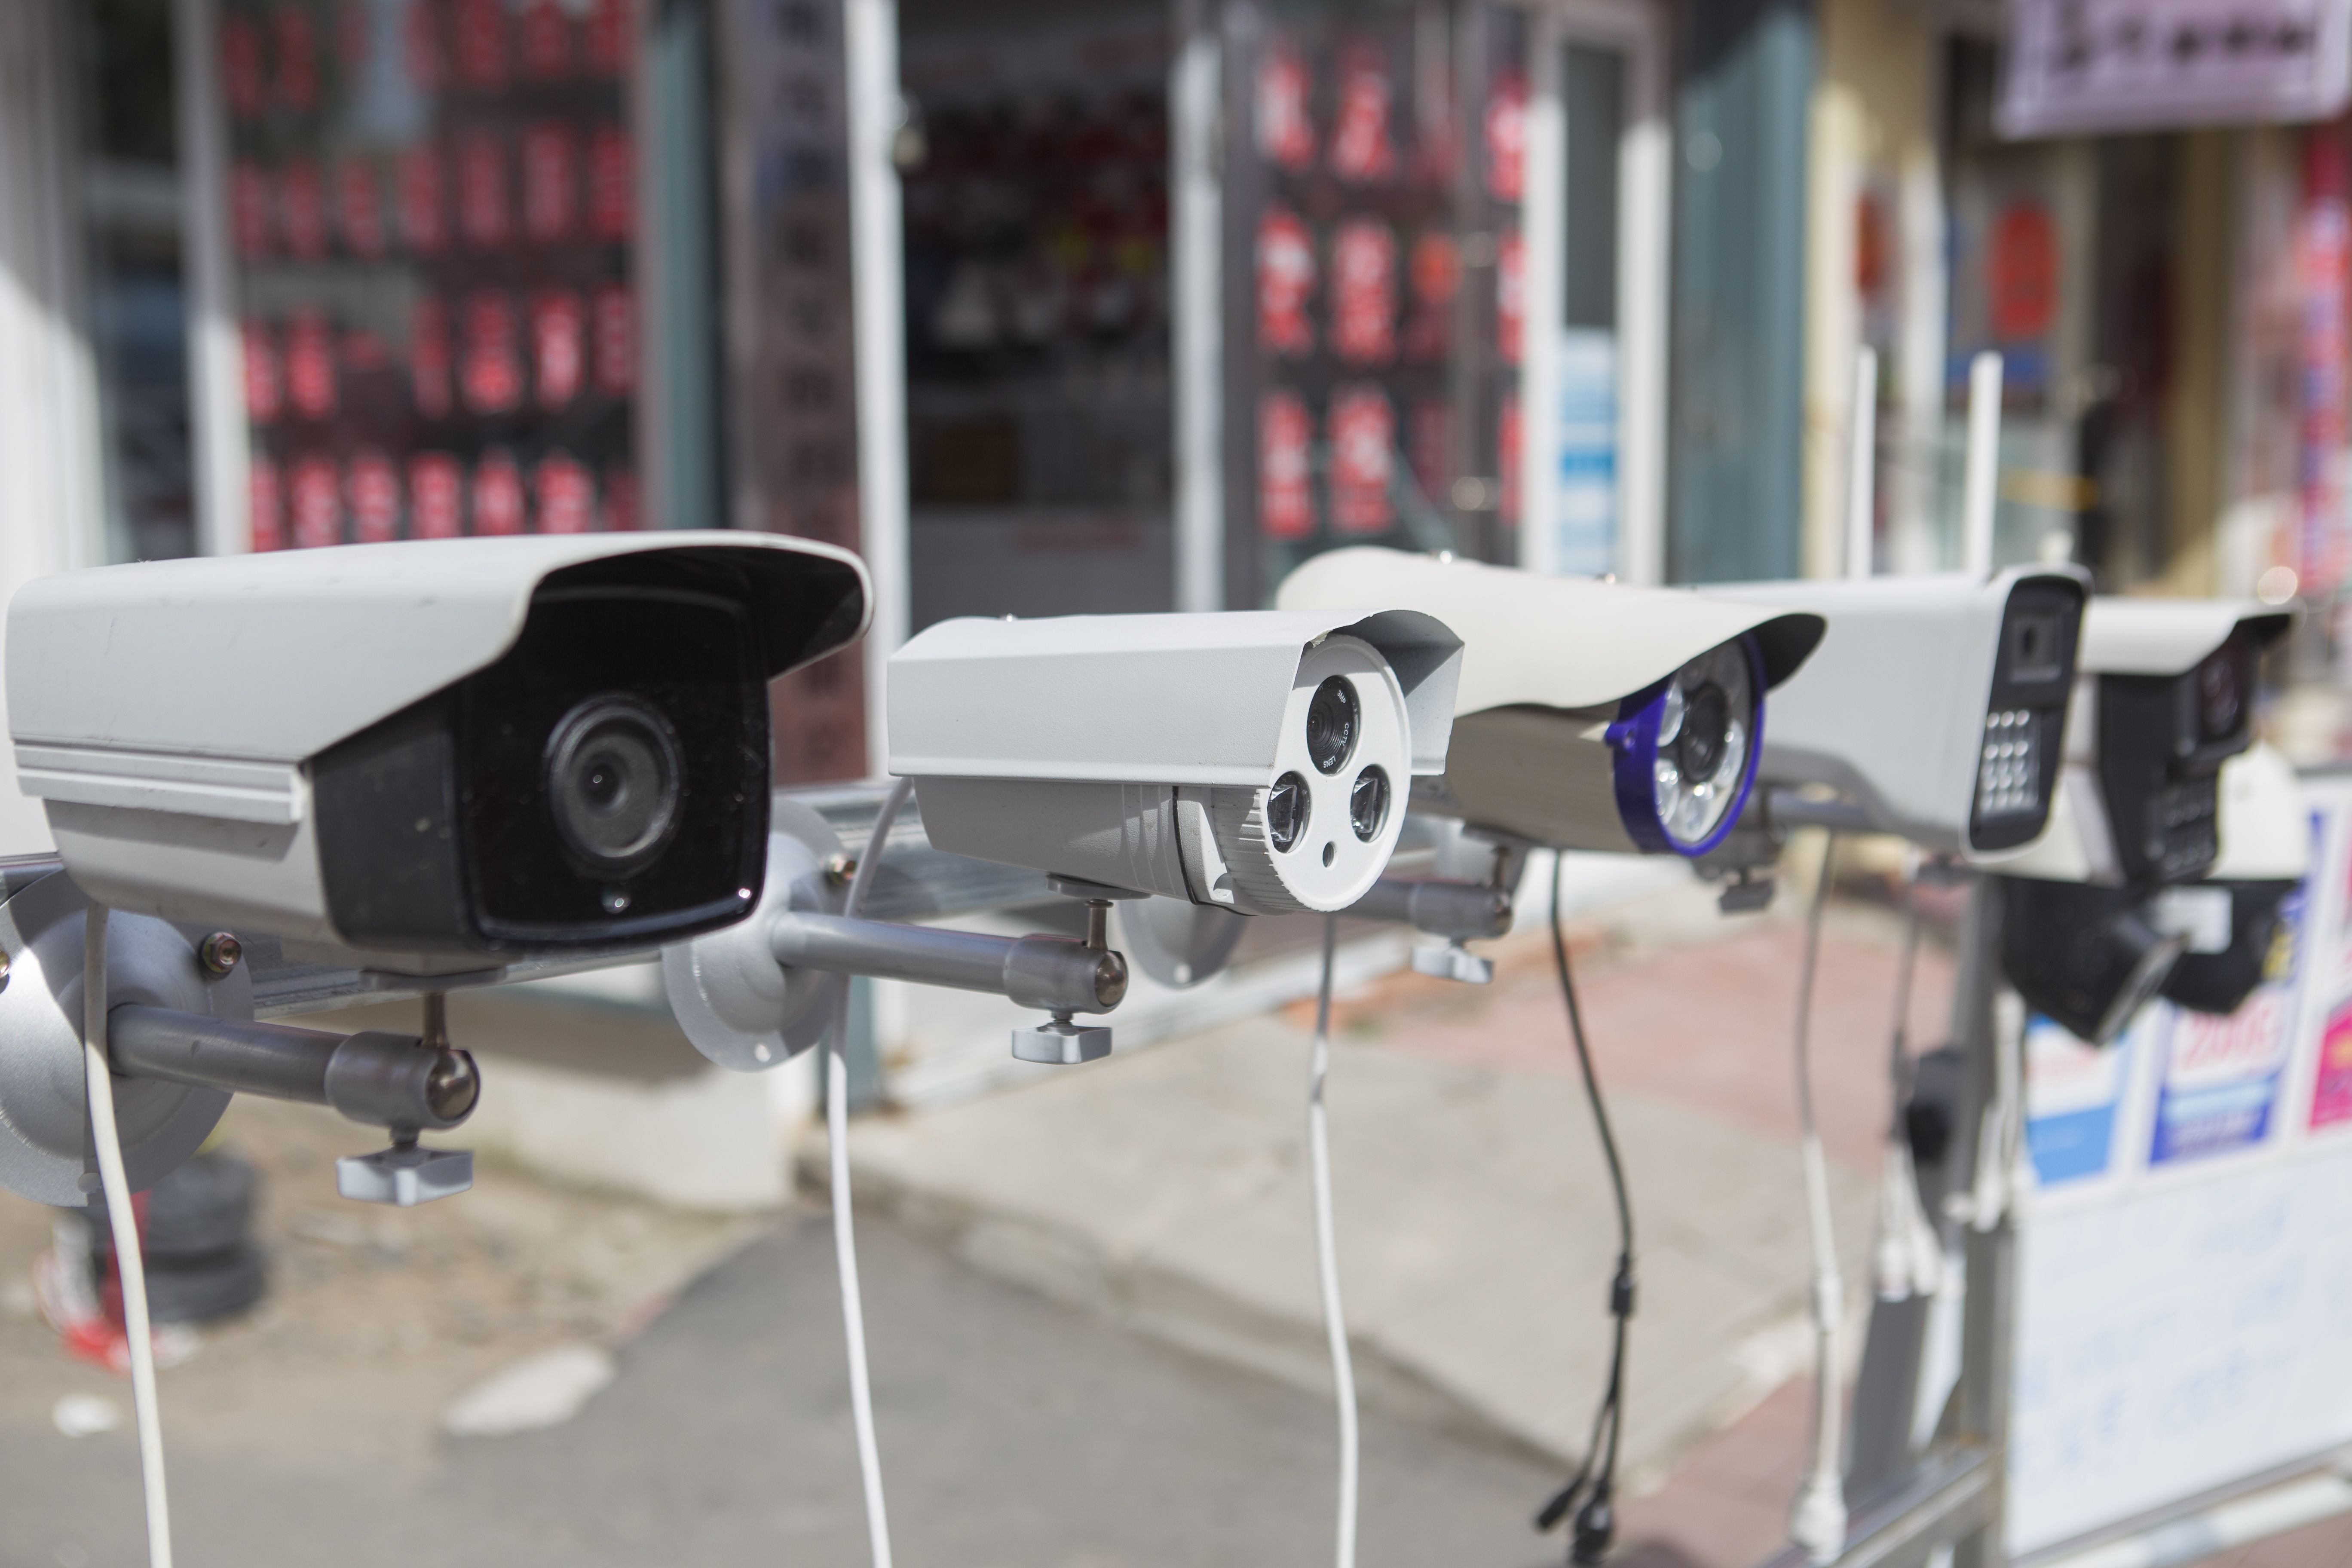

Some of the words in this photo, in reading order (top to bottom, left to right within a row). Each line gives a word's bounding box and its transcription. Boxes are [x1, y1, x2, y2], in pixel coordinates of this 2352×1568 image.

[1337, 690, 1346, 704] 3MP
[1341, 723, 1349, 747] CCTV
[1323, 756, 1336, 768] LENS
